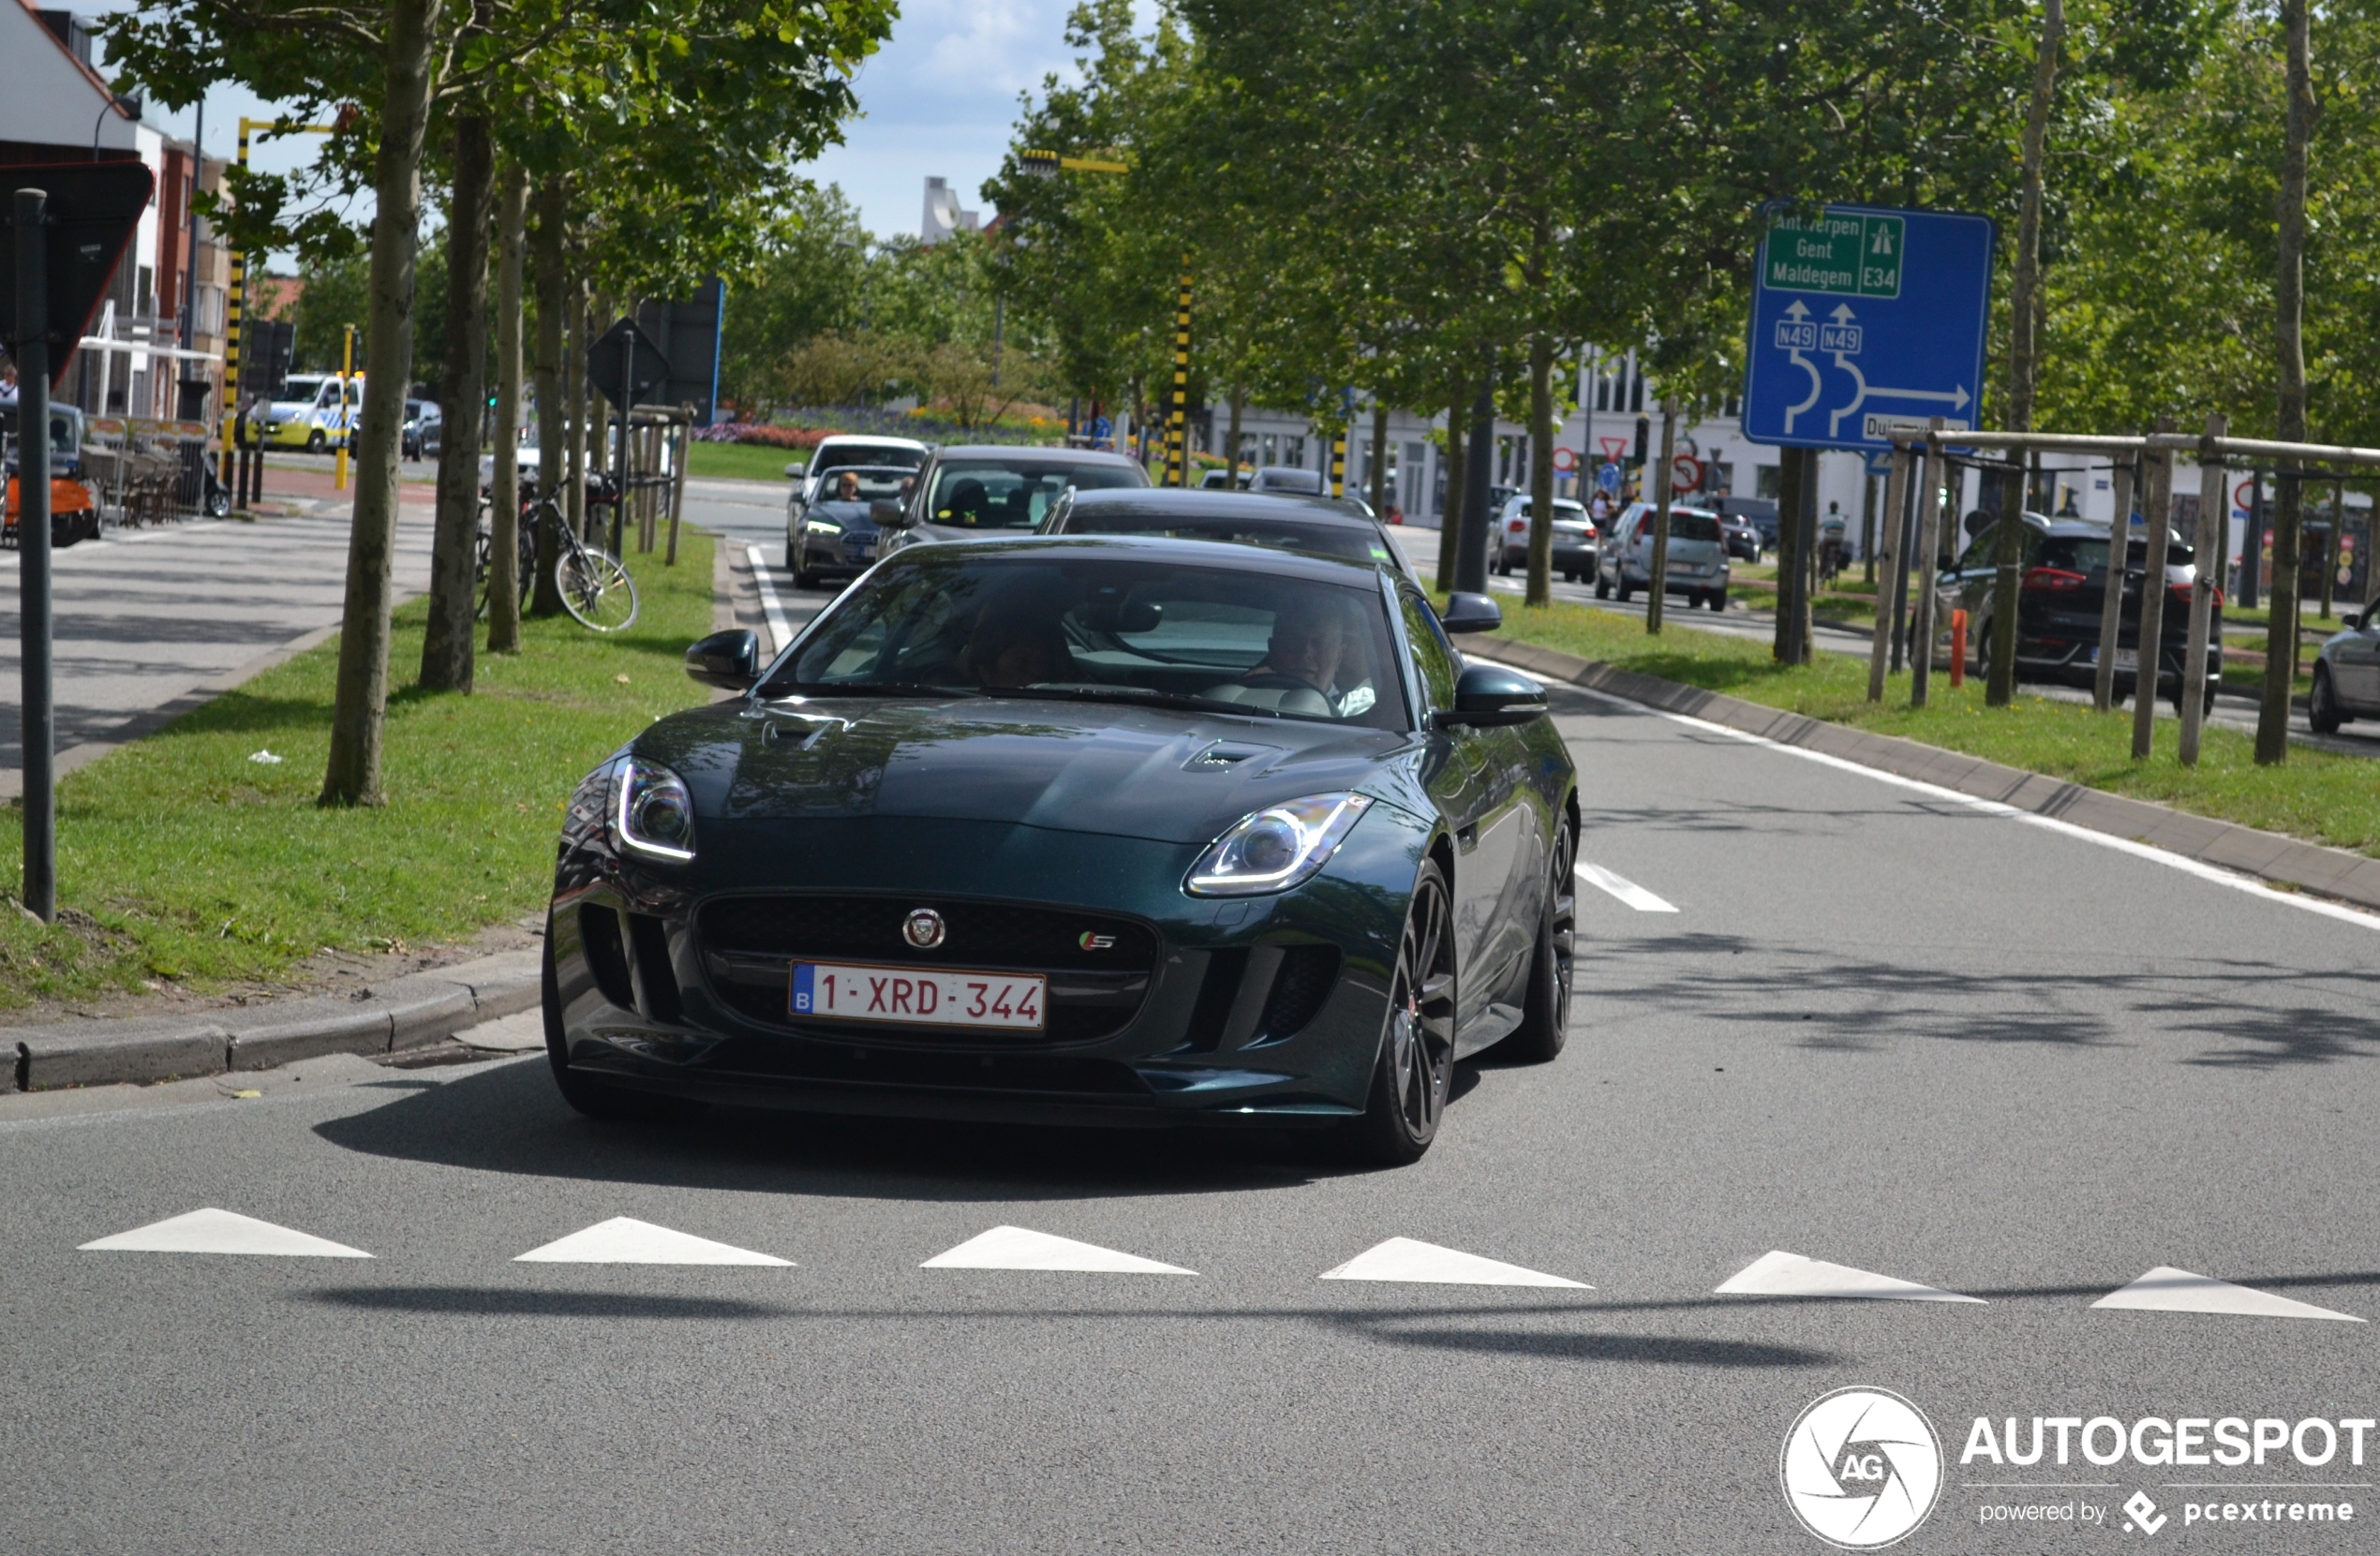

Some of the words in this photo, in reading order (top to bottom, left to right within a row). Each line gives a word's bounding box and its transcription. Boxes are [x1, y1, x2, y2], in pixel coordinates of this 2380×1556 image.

[1796, 238, 1833, 259] Gent
[1773, 262, 1852, 289] Maldegem
[1863, 267, 1896, 289] E34
[1779, 326, 1812, 346] N49
[1823, 330, 1857, 350] N49
[796, 992, 810, 1010] B
[823, 974, 1037, 1020] 1-XRD-344
